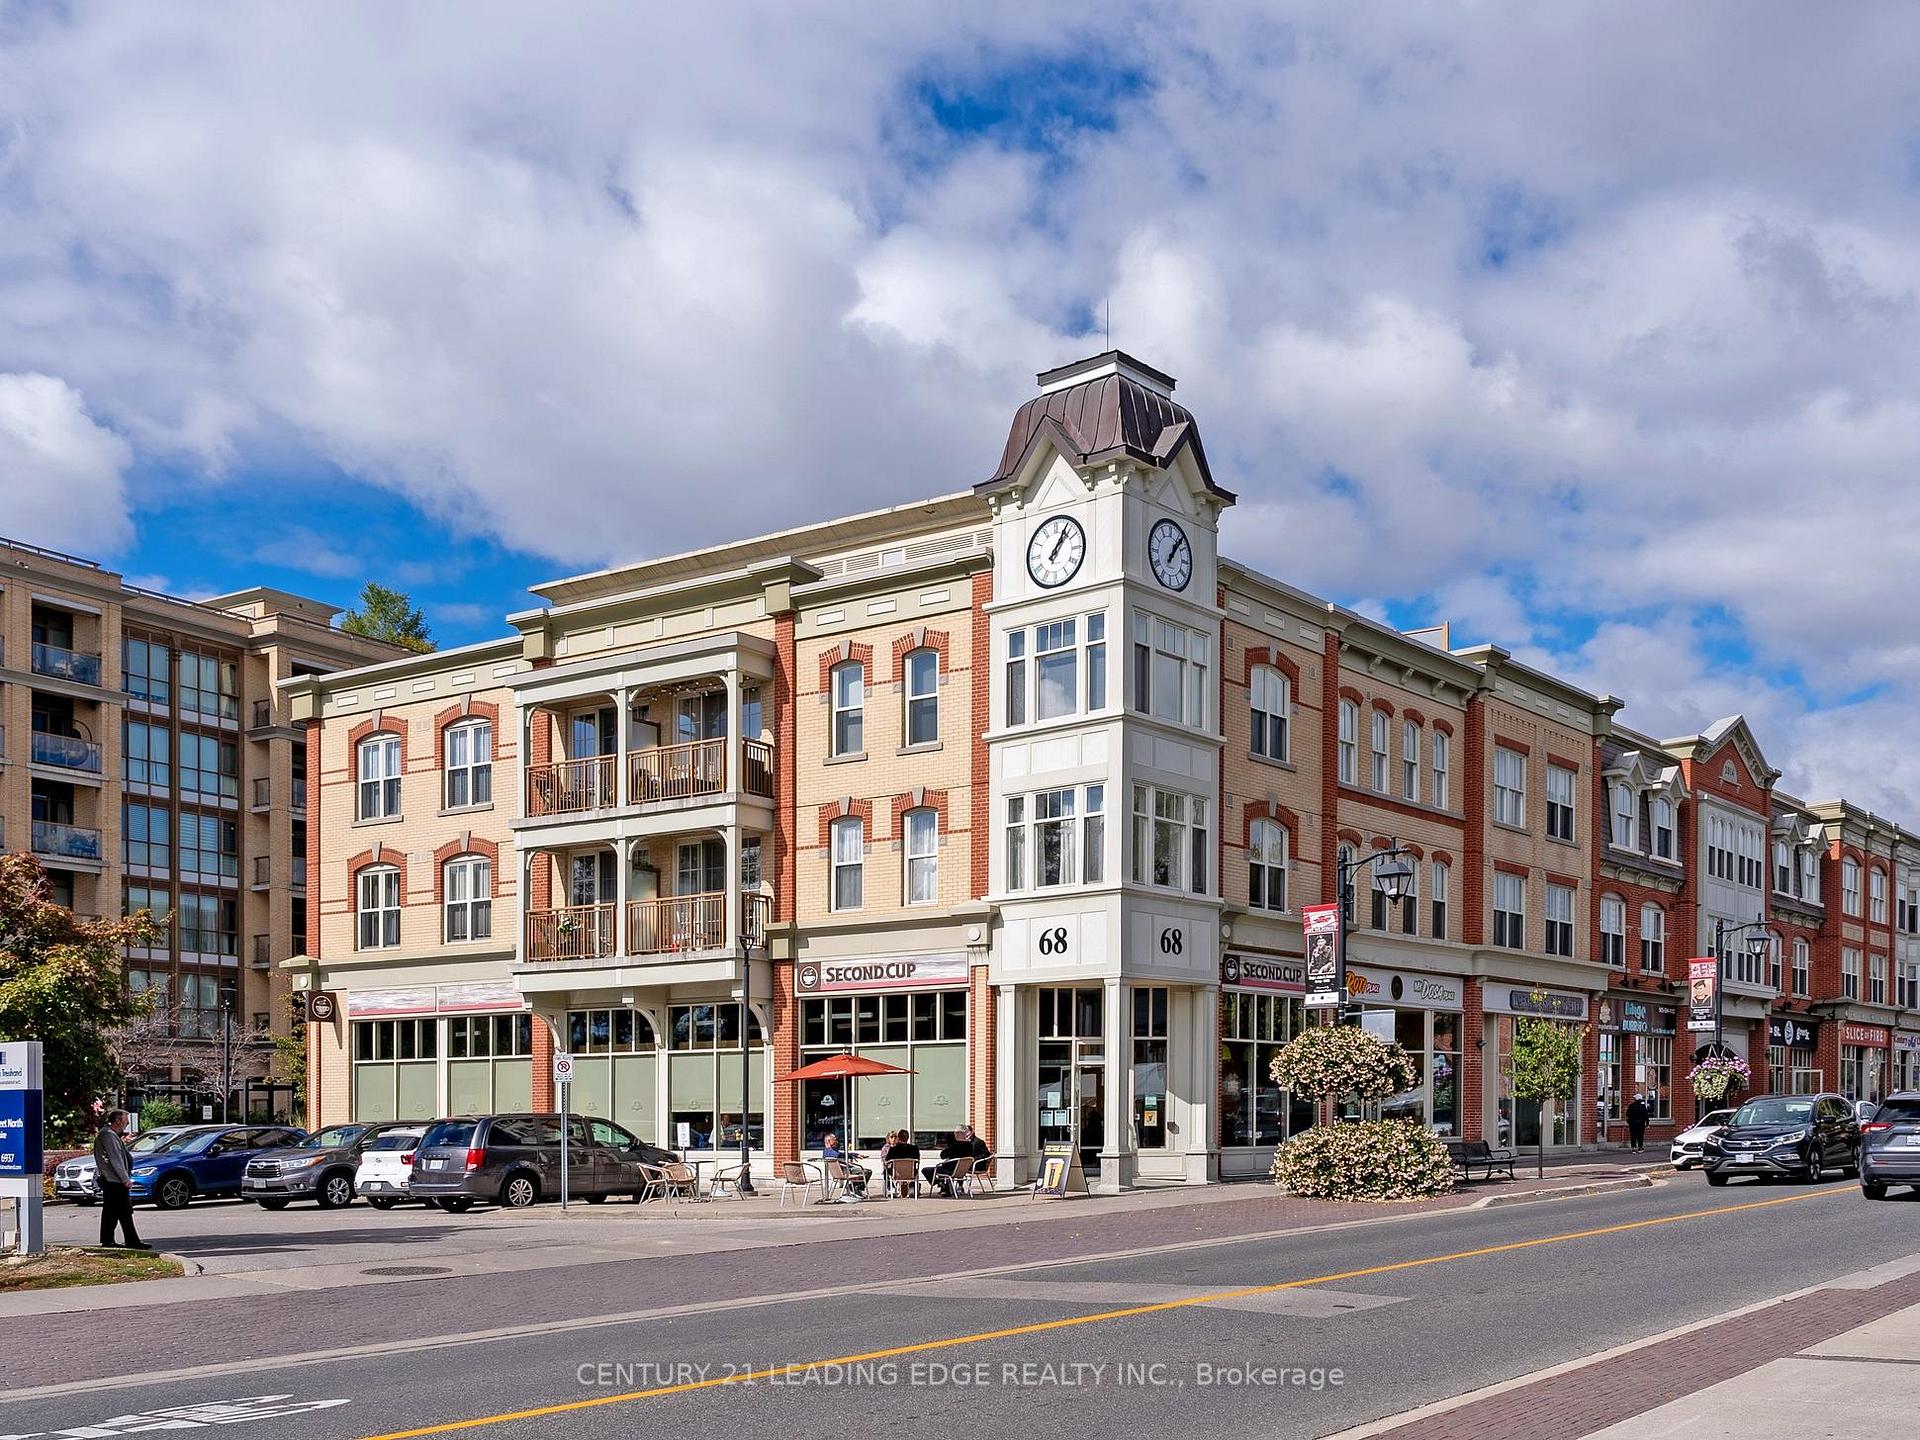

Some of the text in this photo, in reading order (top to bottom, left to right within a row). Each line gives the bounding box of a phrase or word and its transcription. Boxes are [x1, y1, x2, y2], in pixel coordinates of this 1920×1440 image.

[1039, 927, 1068, 955] 68
[1160, 927, 1183, 955] 68
[825, 962, 917, 983] SECOND CUP
[1243, 962, 1301, 982] SECOND CUP
[1845, 1026, 1864, 1041] SLICE
[1869, 1029, 1884, 1042] FIRE
[8, 1118, 24, 1128] North
